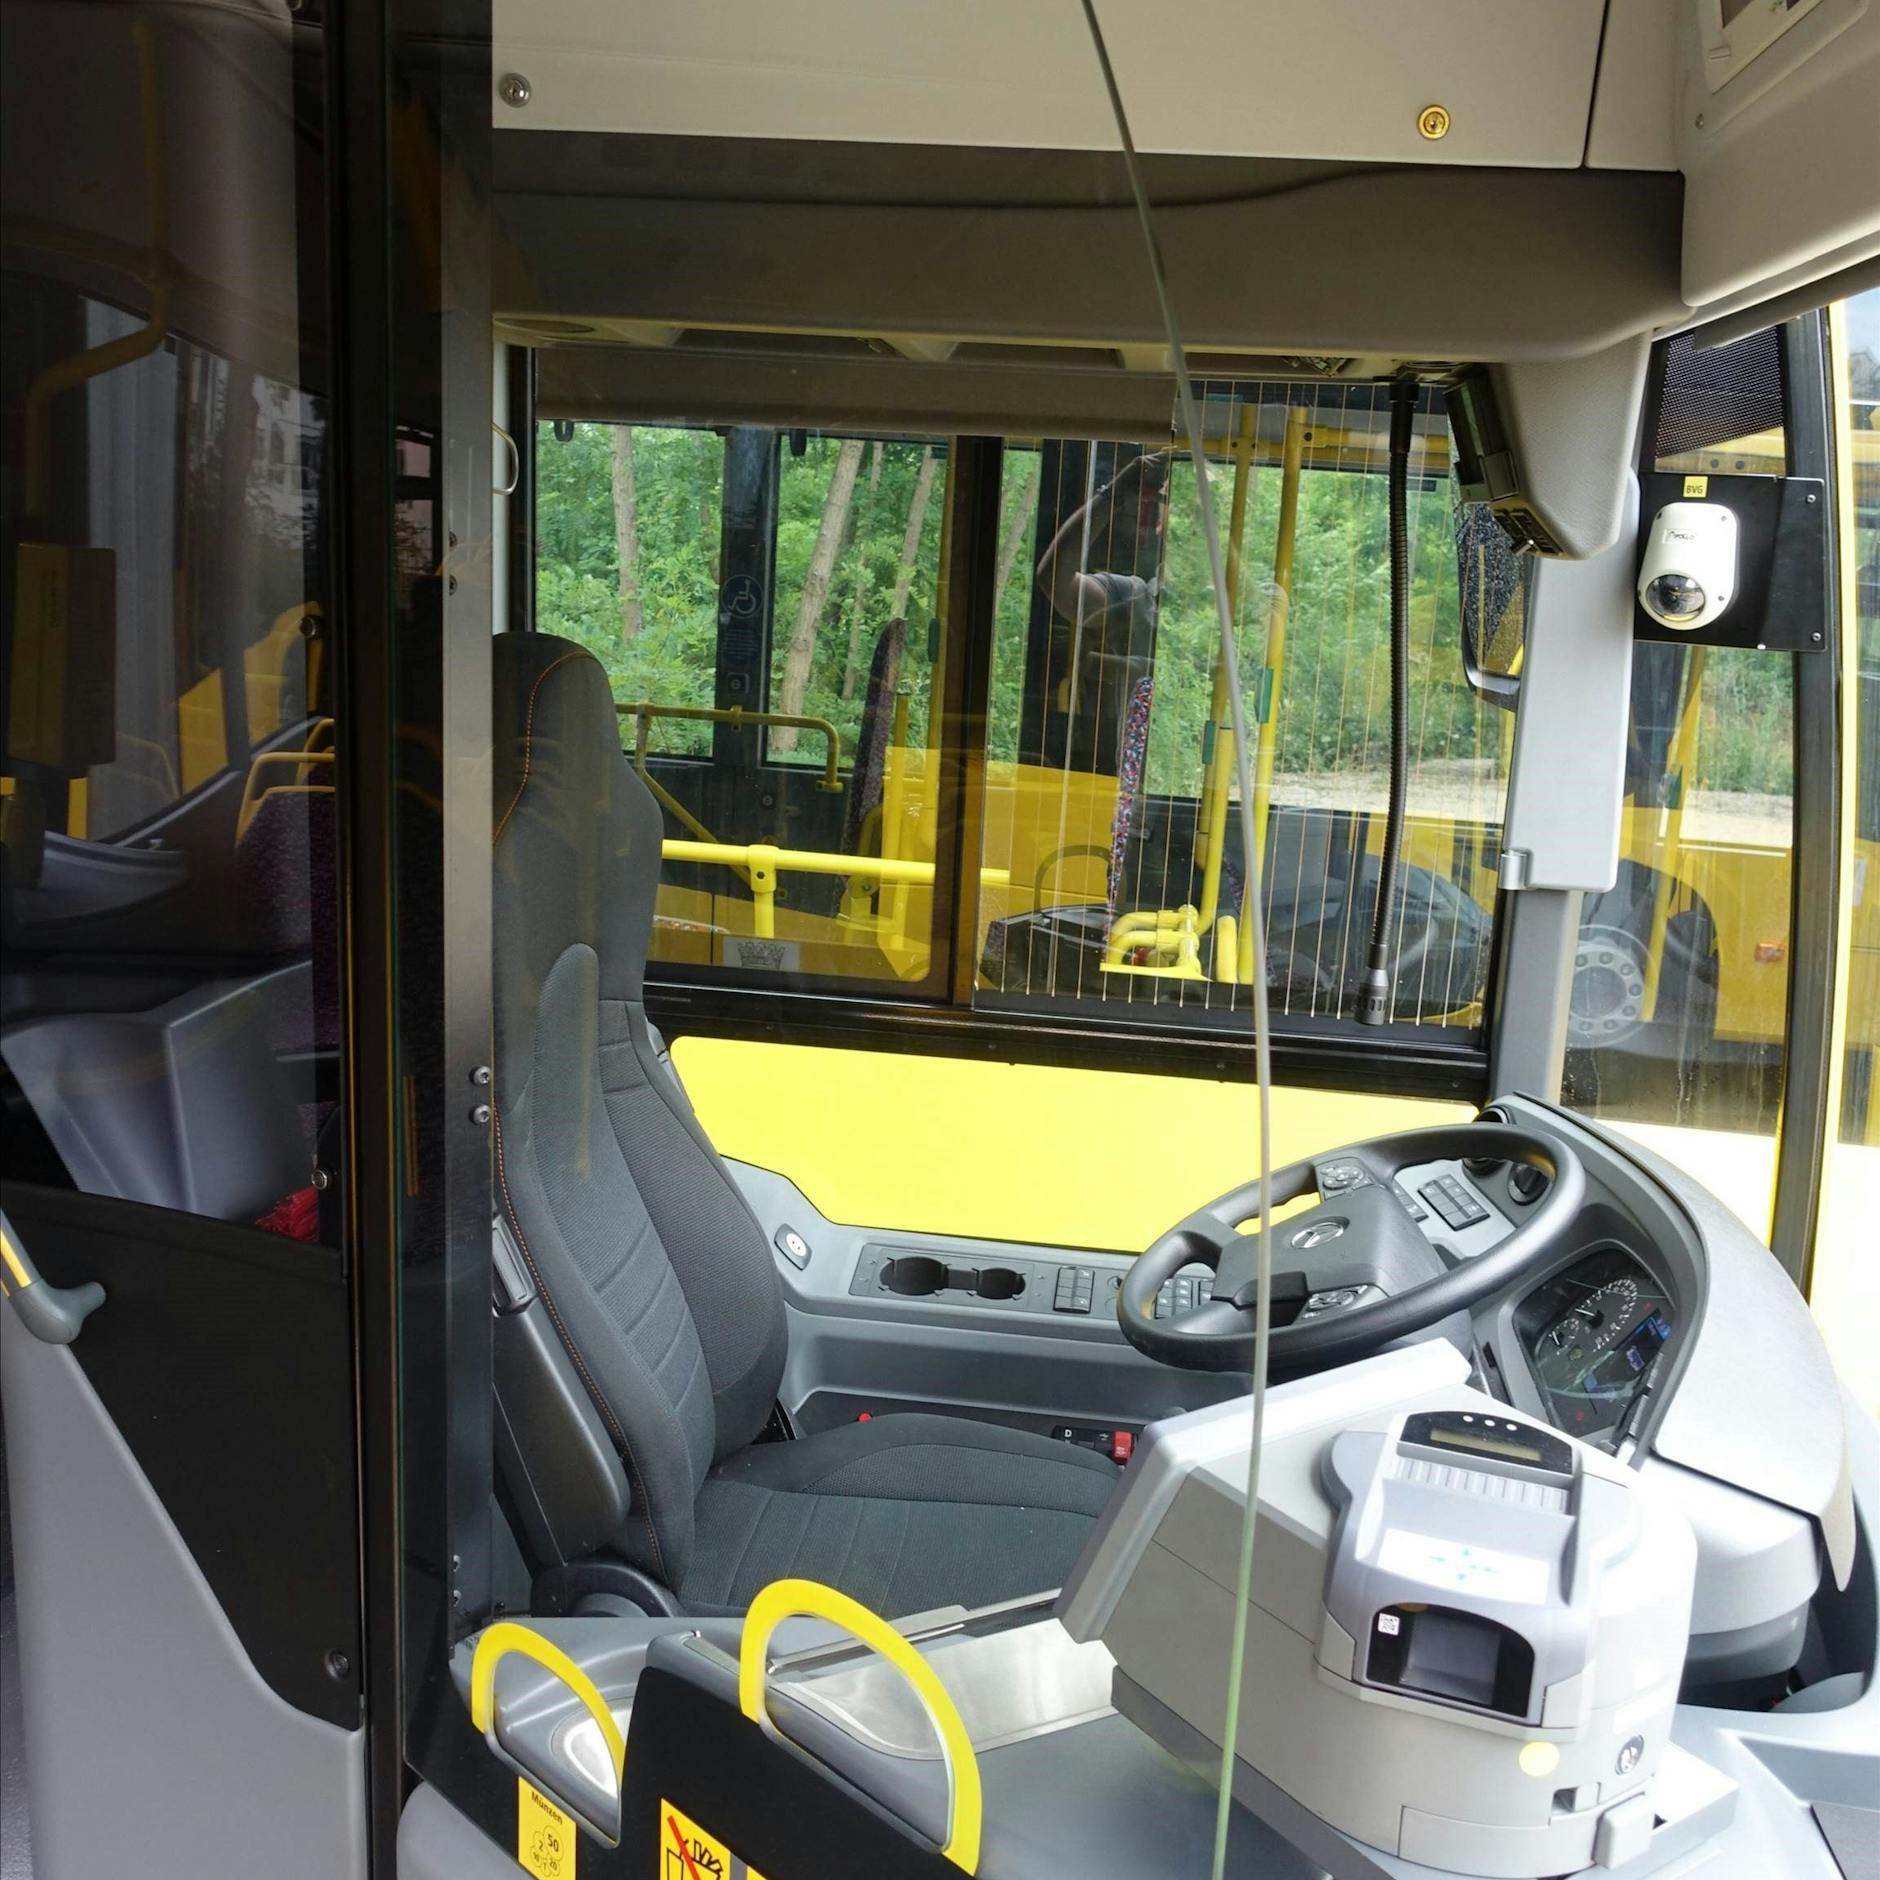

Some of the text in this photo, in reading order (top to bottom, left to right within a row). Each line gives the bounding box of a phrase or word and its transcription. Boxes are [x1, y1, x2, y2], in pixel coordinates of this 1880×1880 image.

[1686, 485, 1703, 494] BVG
[531, 1791, 563, 1825] Münzen
[547, 1833, 559, 1852] 50
